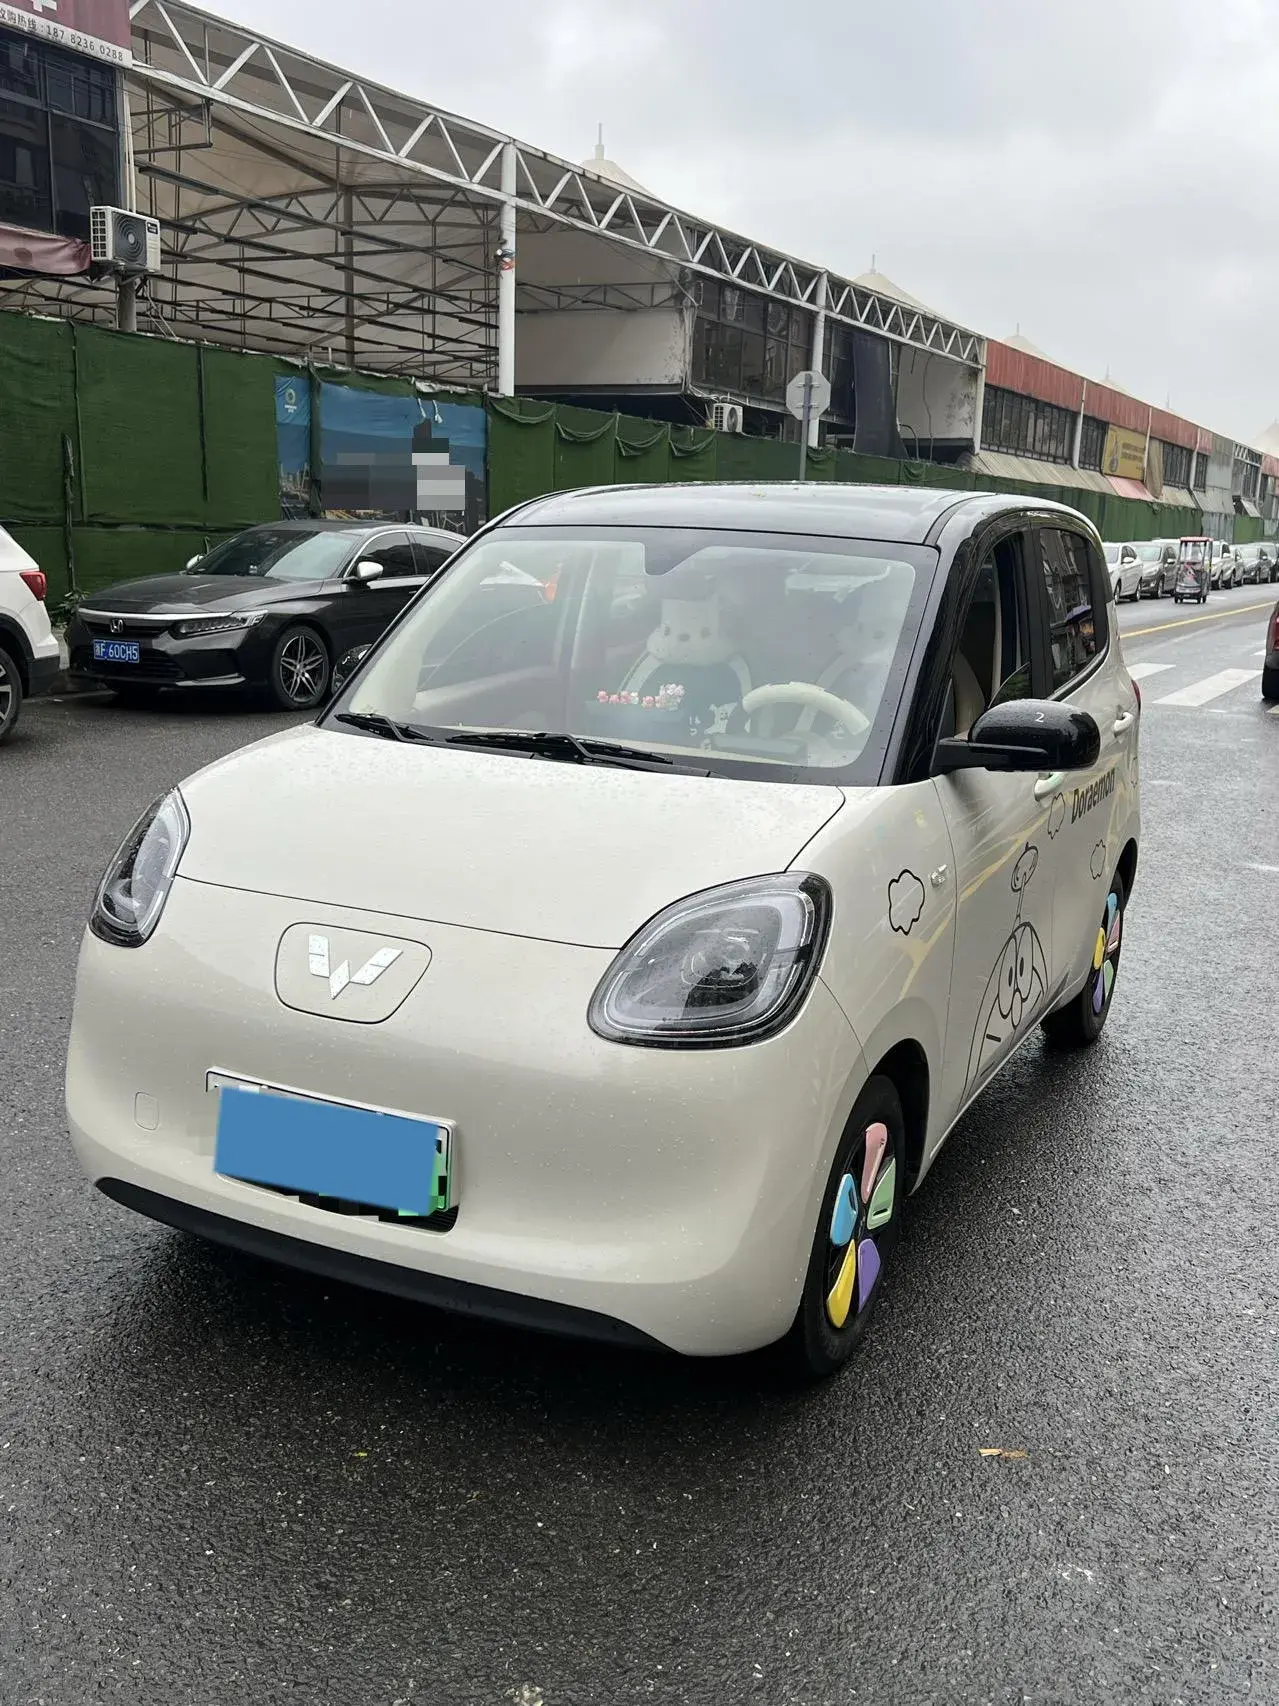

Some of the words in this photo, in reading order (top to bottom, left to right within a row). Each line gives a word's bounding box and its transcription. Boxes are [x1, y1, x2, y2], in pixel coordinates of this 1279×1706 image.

[70, 34, 95, 51] 8236
[99, 45, 123, 61] 0288
[1035, 712, 1045, 722] 2
[1071, 768, 1115, 824] Doraemon
